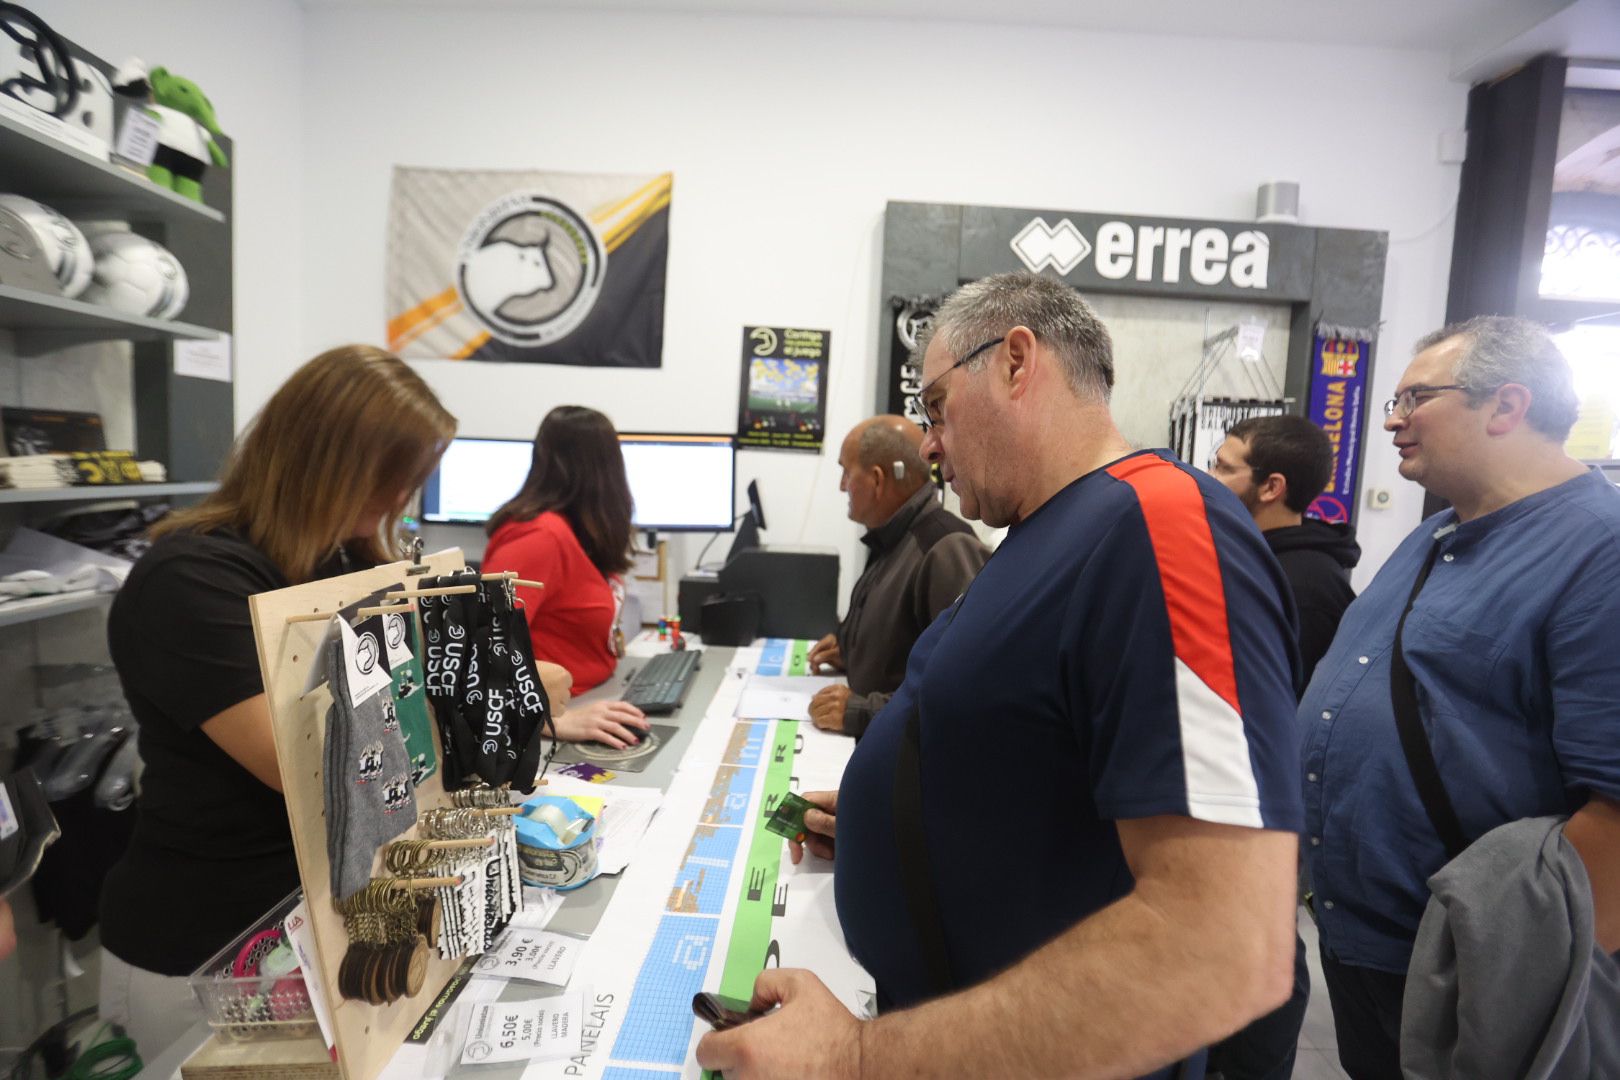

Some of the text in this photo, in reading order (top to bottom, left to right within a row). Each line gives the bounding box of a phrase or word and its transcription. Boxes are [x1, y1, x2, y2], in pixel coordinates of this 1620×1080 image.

[1095, 221, 1270, 289] errea
[426, 646, 442, 696] USCF
[440, 643, 463, 697] USCF
[515, 665, 544, 714] USCF
[485, 688, 504, 736] USCF
[505, 946, 527, 966] 3,90
[500, 1014, 519, 1048] 6,50€
[522, 1018, 533, 1041] 5,00€
[551, 1013, 560, 1039] LLAVERO
[560, 1011, 569, 1038] MADERA
